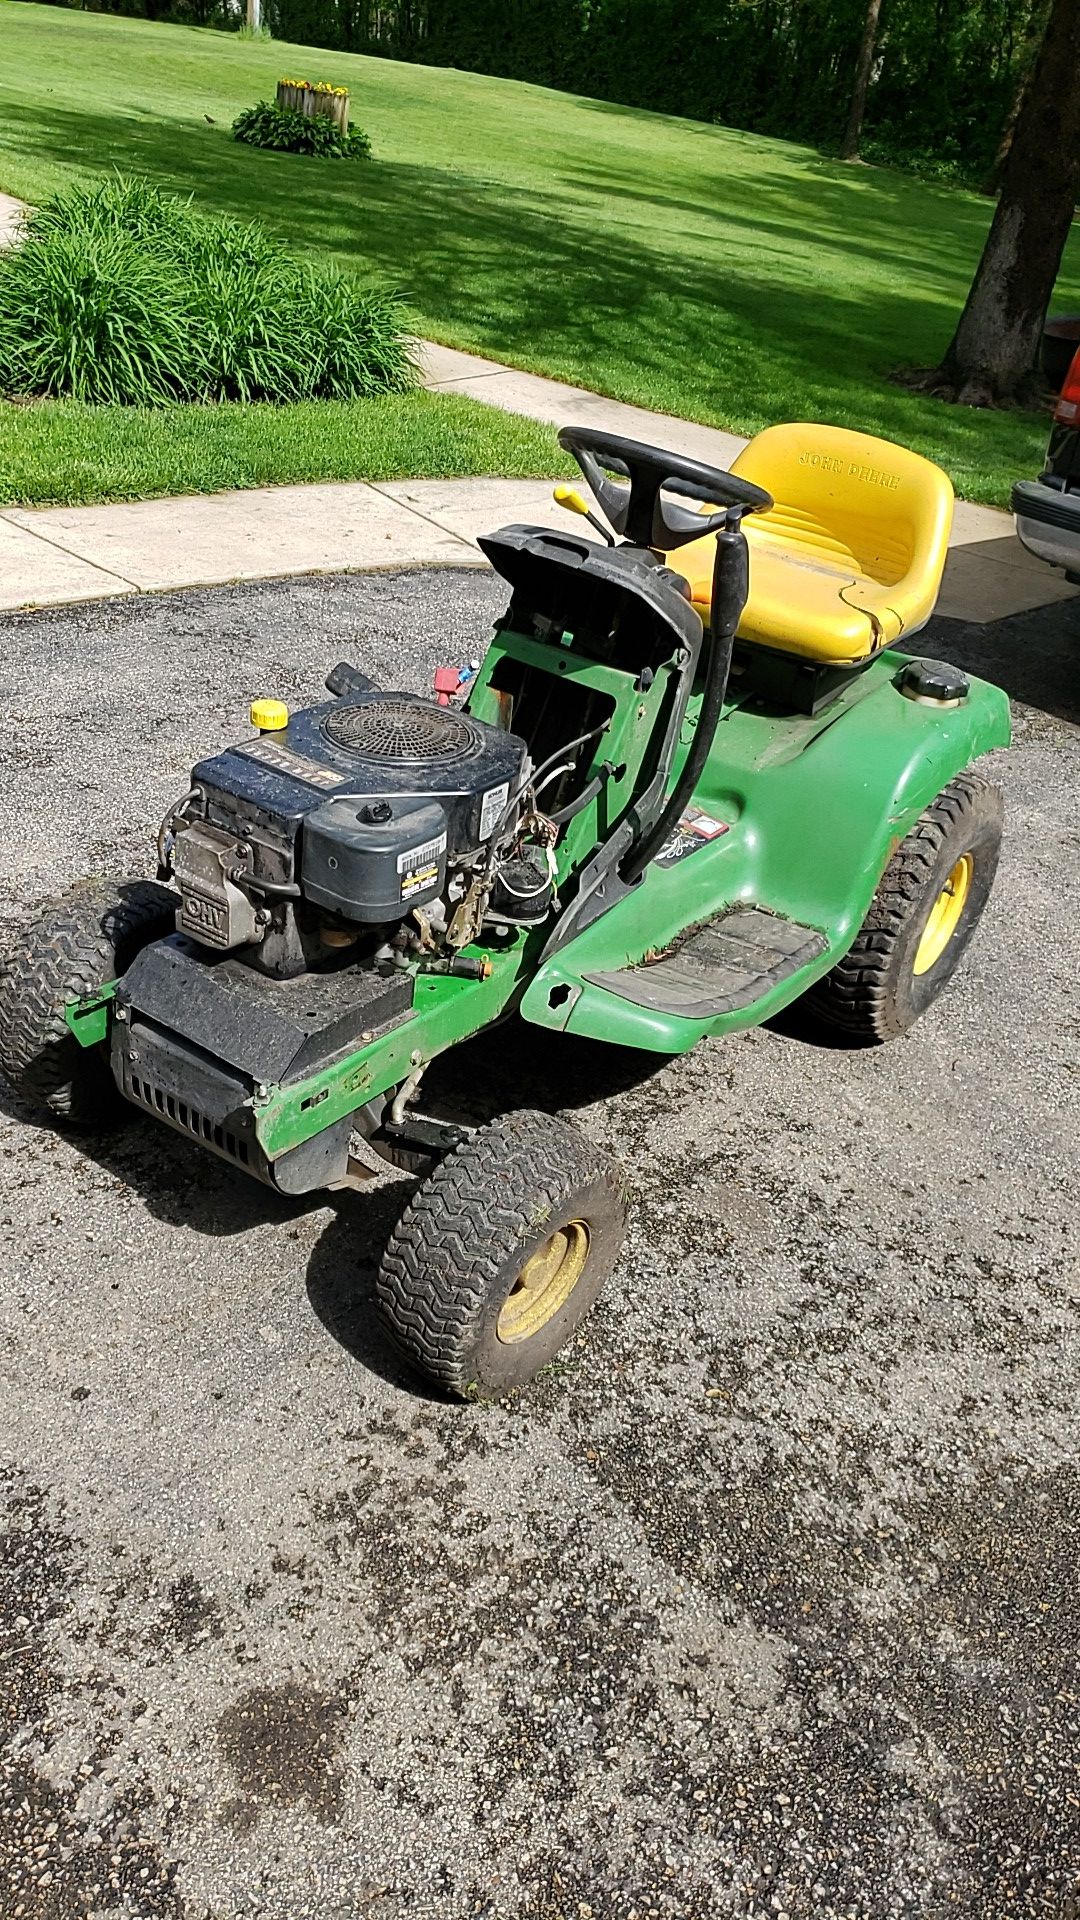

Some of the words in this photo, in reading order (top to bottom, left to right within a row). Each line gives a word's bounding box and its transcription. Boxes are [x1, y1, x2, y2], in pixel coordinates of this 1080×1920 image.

[799, 452, 844, 473] JOHN
[847, 463, 900, 490] DEERE
[186, 898, 225, 929] OHV
